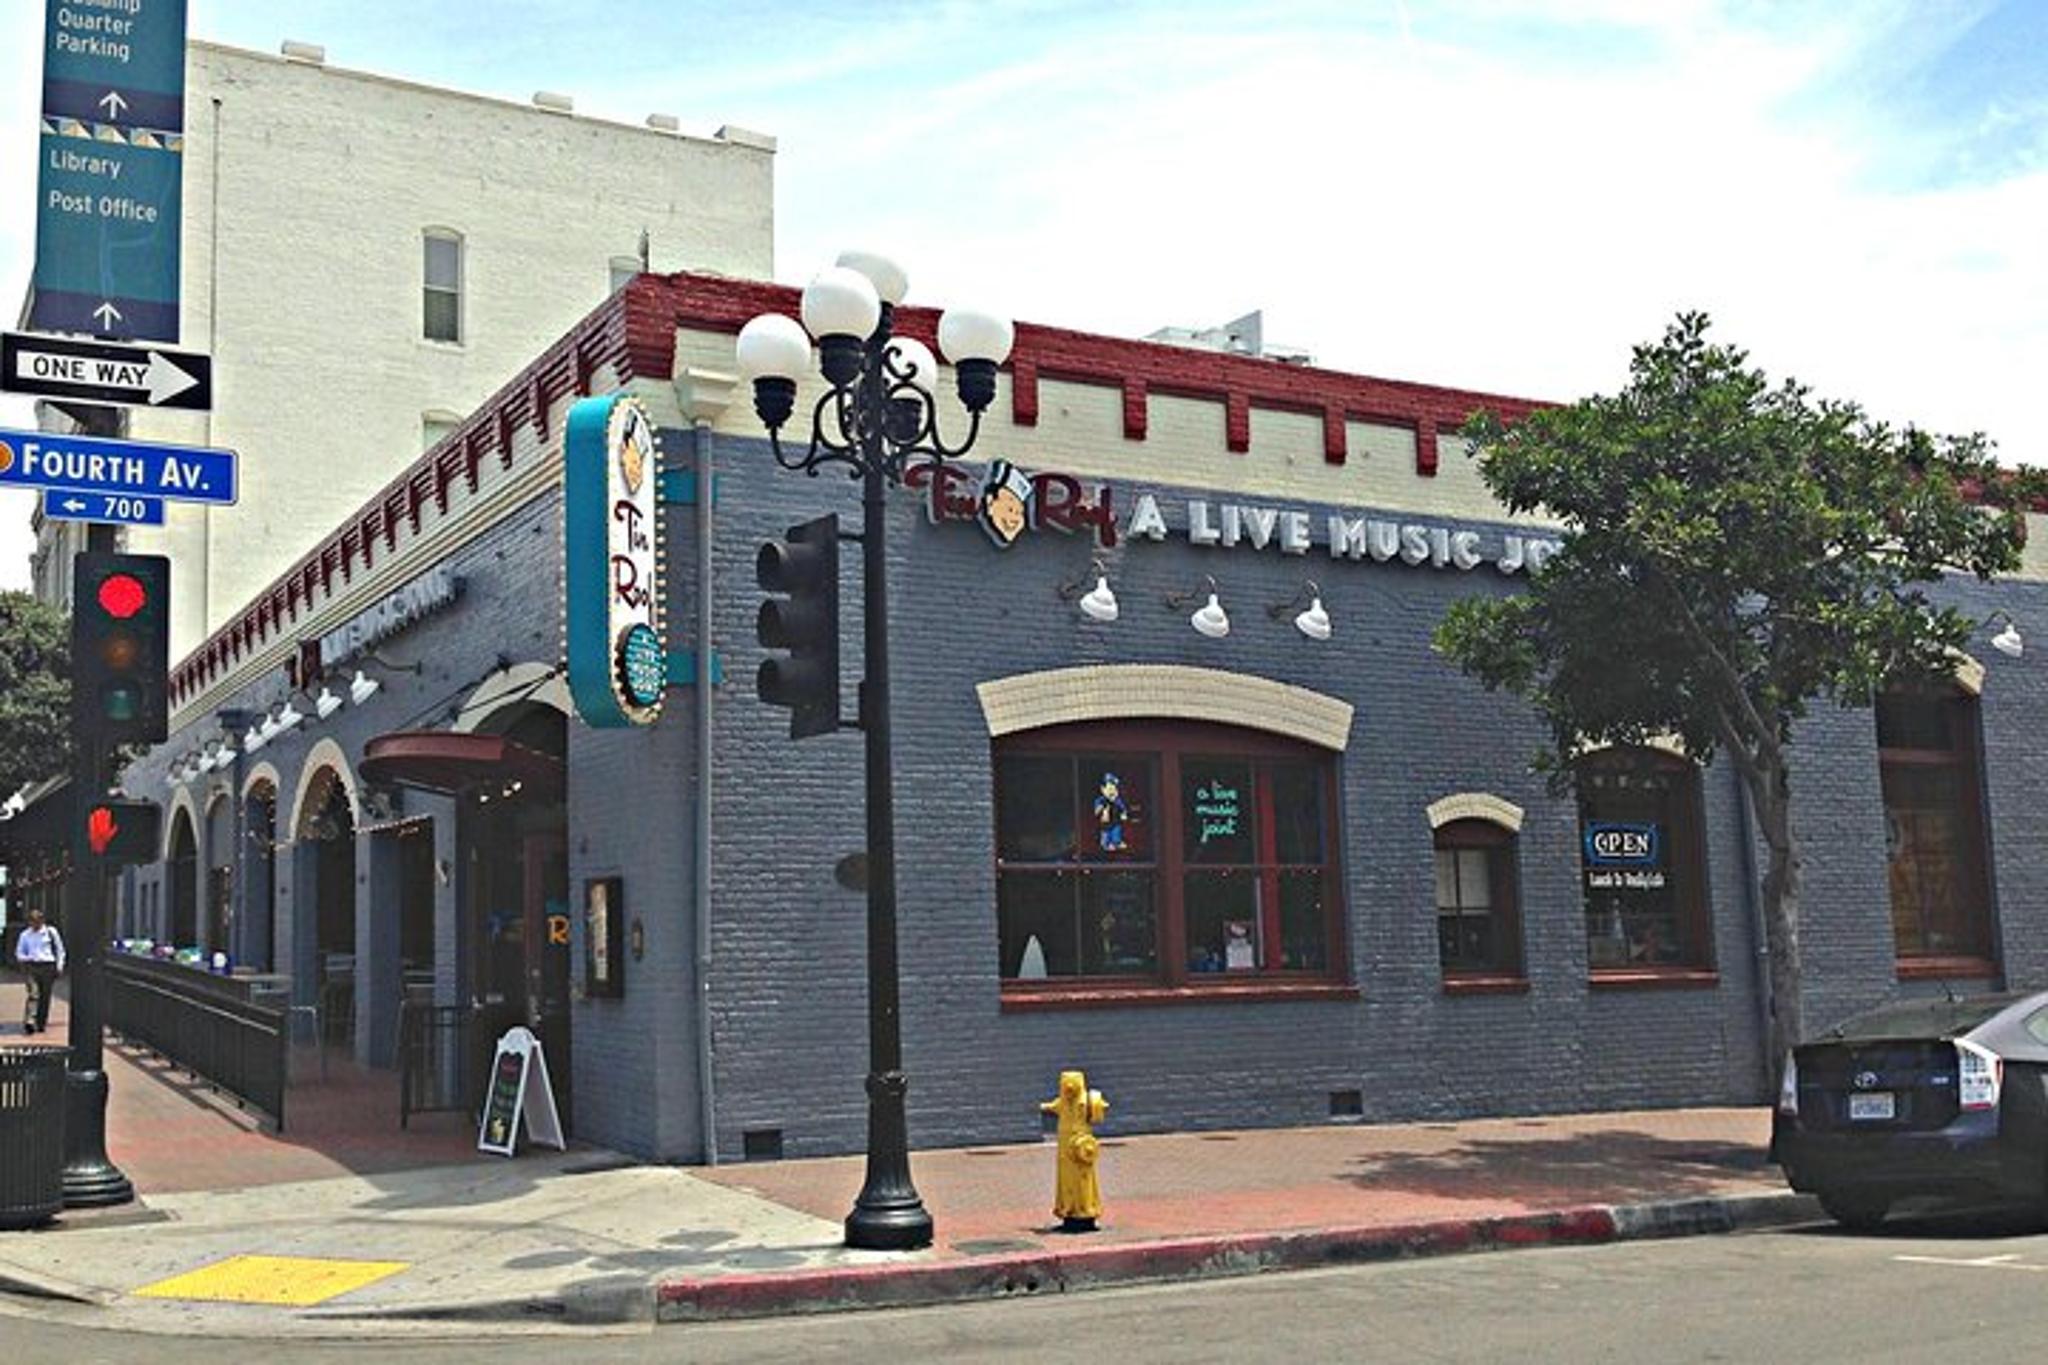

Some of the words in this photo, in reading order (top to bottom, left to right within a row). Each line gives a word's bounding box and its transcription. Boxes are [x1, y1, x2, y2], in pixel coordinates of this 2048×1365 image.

[58, 7, 134, 36] Quarter
[56, 31, 130, 63] Parking
[50, 149, 121, 179] Library
[49, 189, 92, 214] Post
[98, 196, 158, 223] Office
[33, 355, 86, 381] ONE
[96, 362, 149, 386] WAY
[104, 497, 146, 520] 700
[614, 499, 650, 552] Tin
[1127, 494, 1168, 541] A
[1188, 500, 1311, 555] LIVE
[1327, 515, 1483, 572] MUSIC
[1200, 818, 1237, 843] joint
[1594, 832, 1649, 852] OPEN
